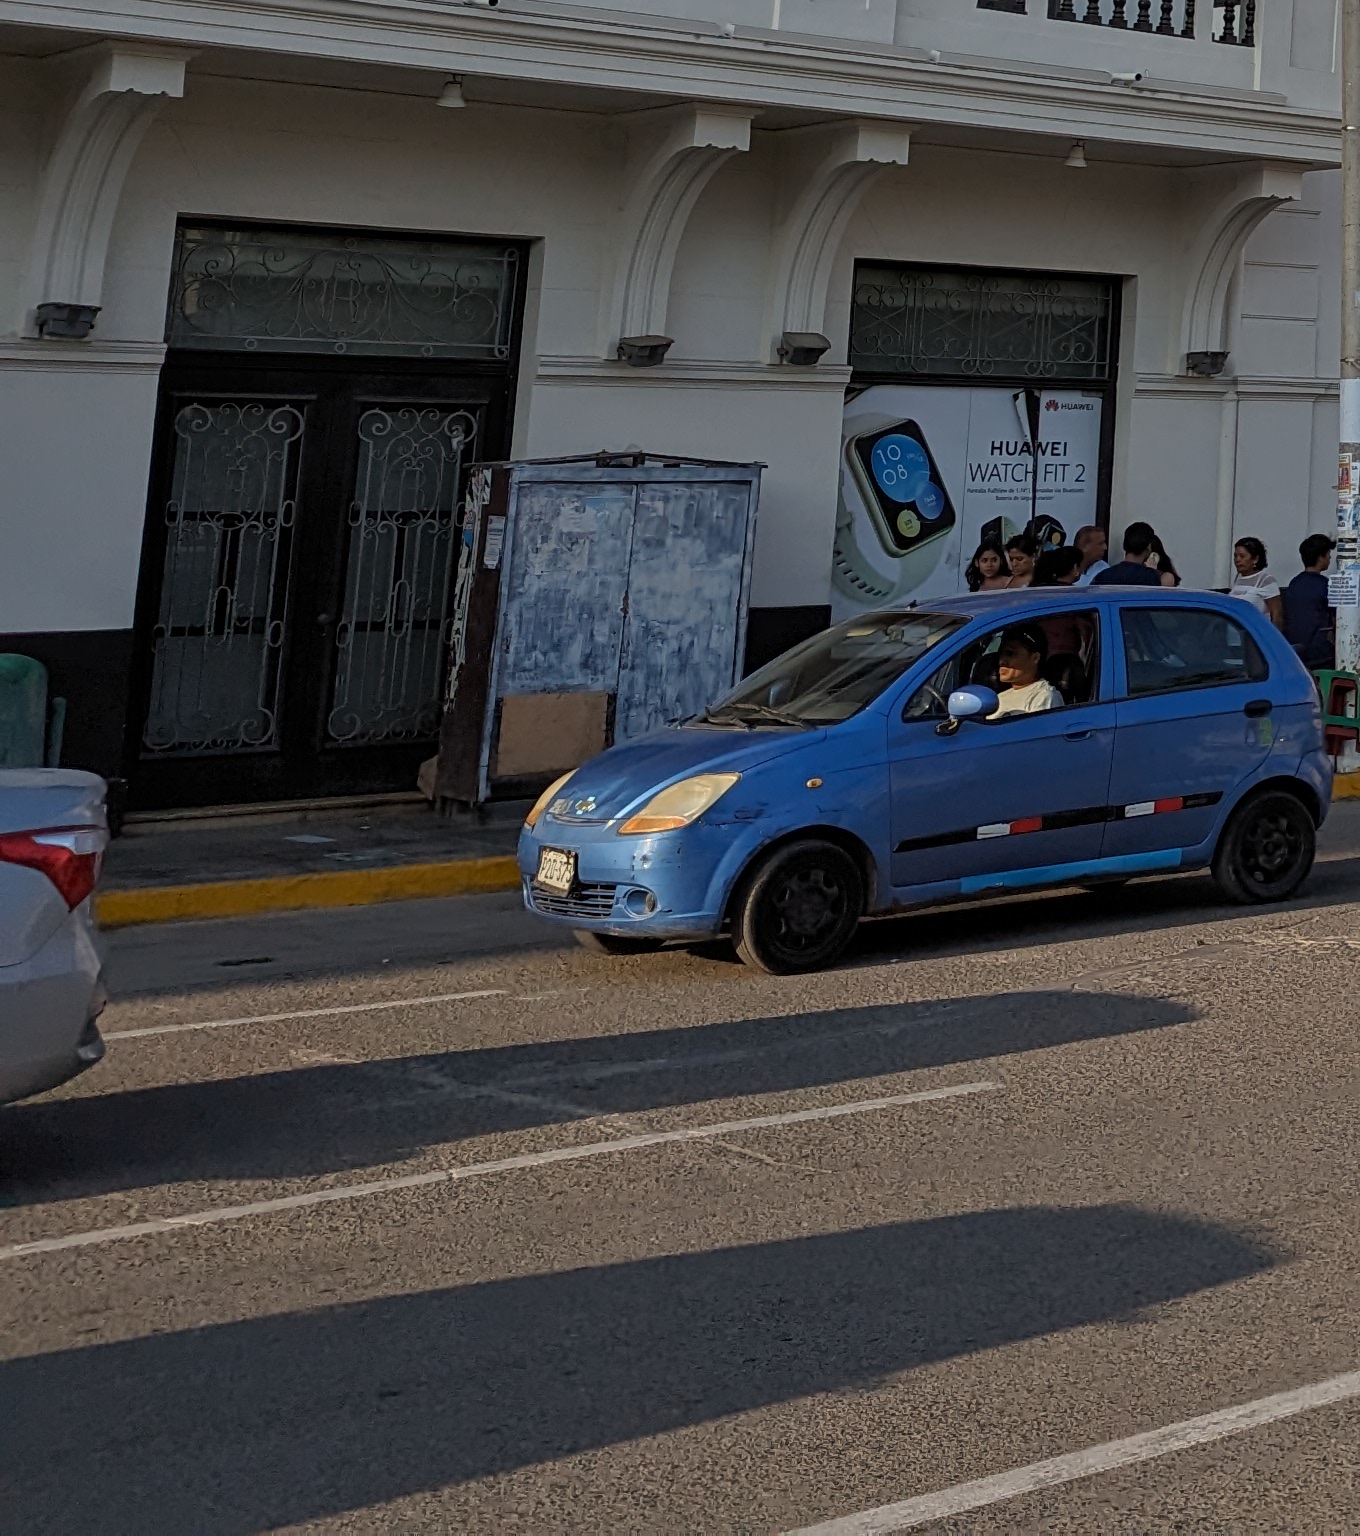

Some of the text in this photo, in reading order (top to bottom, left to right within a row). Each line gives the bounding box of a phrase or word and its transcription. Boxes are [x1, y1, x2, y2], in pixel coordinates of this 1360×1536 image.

[1061, 403, 1093, 411] HUAWEI
[877, 445, 900, 464] 10
[990, 440, 1067, 456] HUAWEI
[883, 464, 907, 484] 08
[968, 462, 1085, 482] WATCH FIT 2
